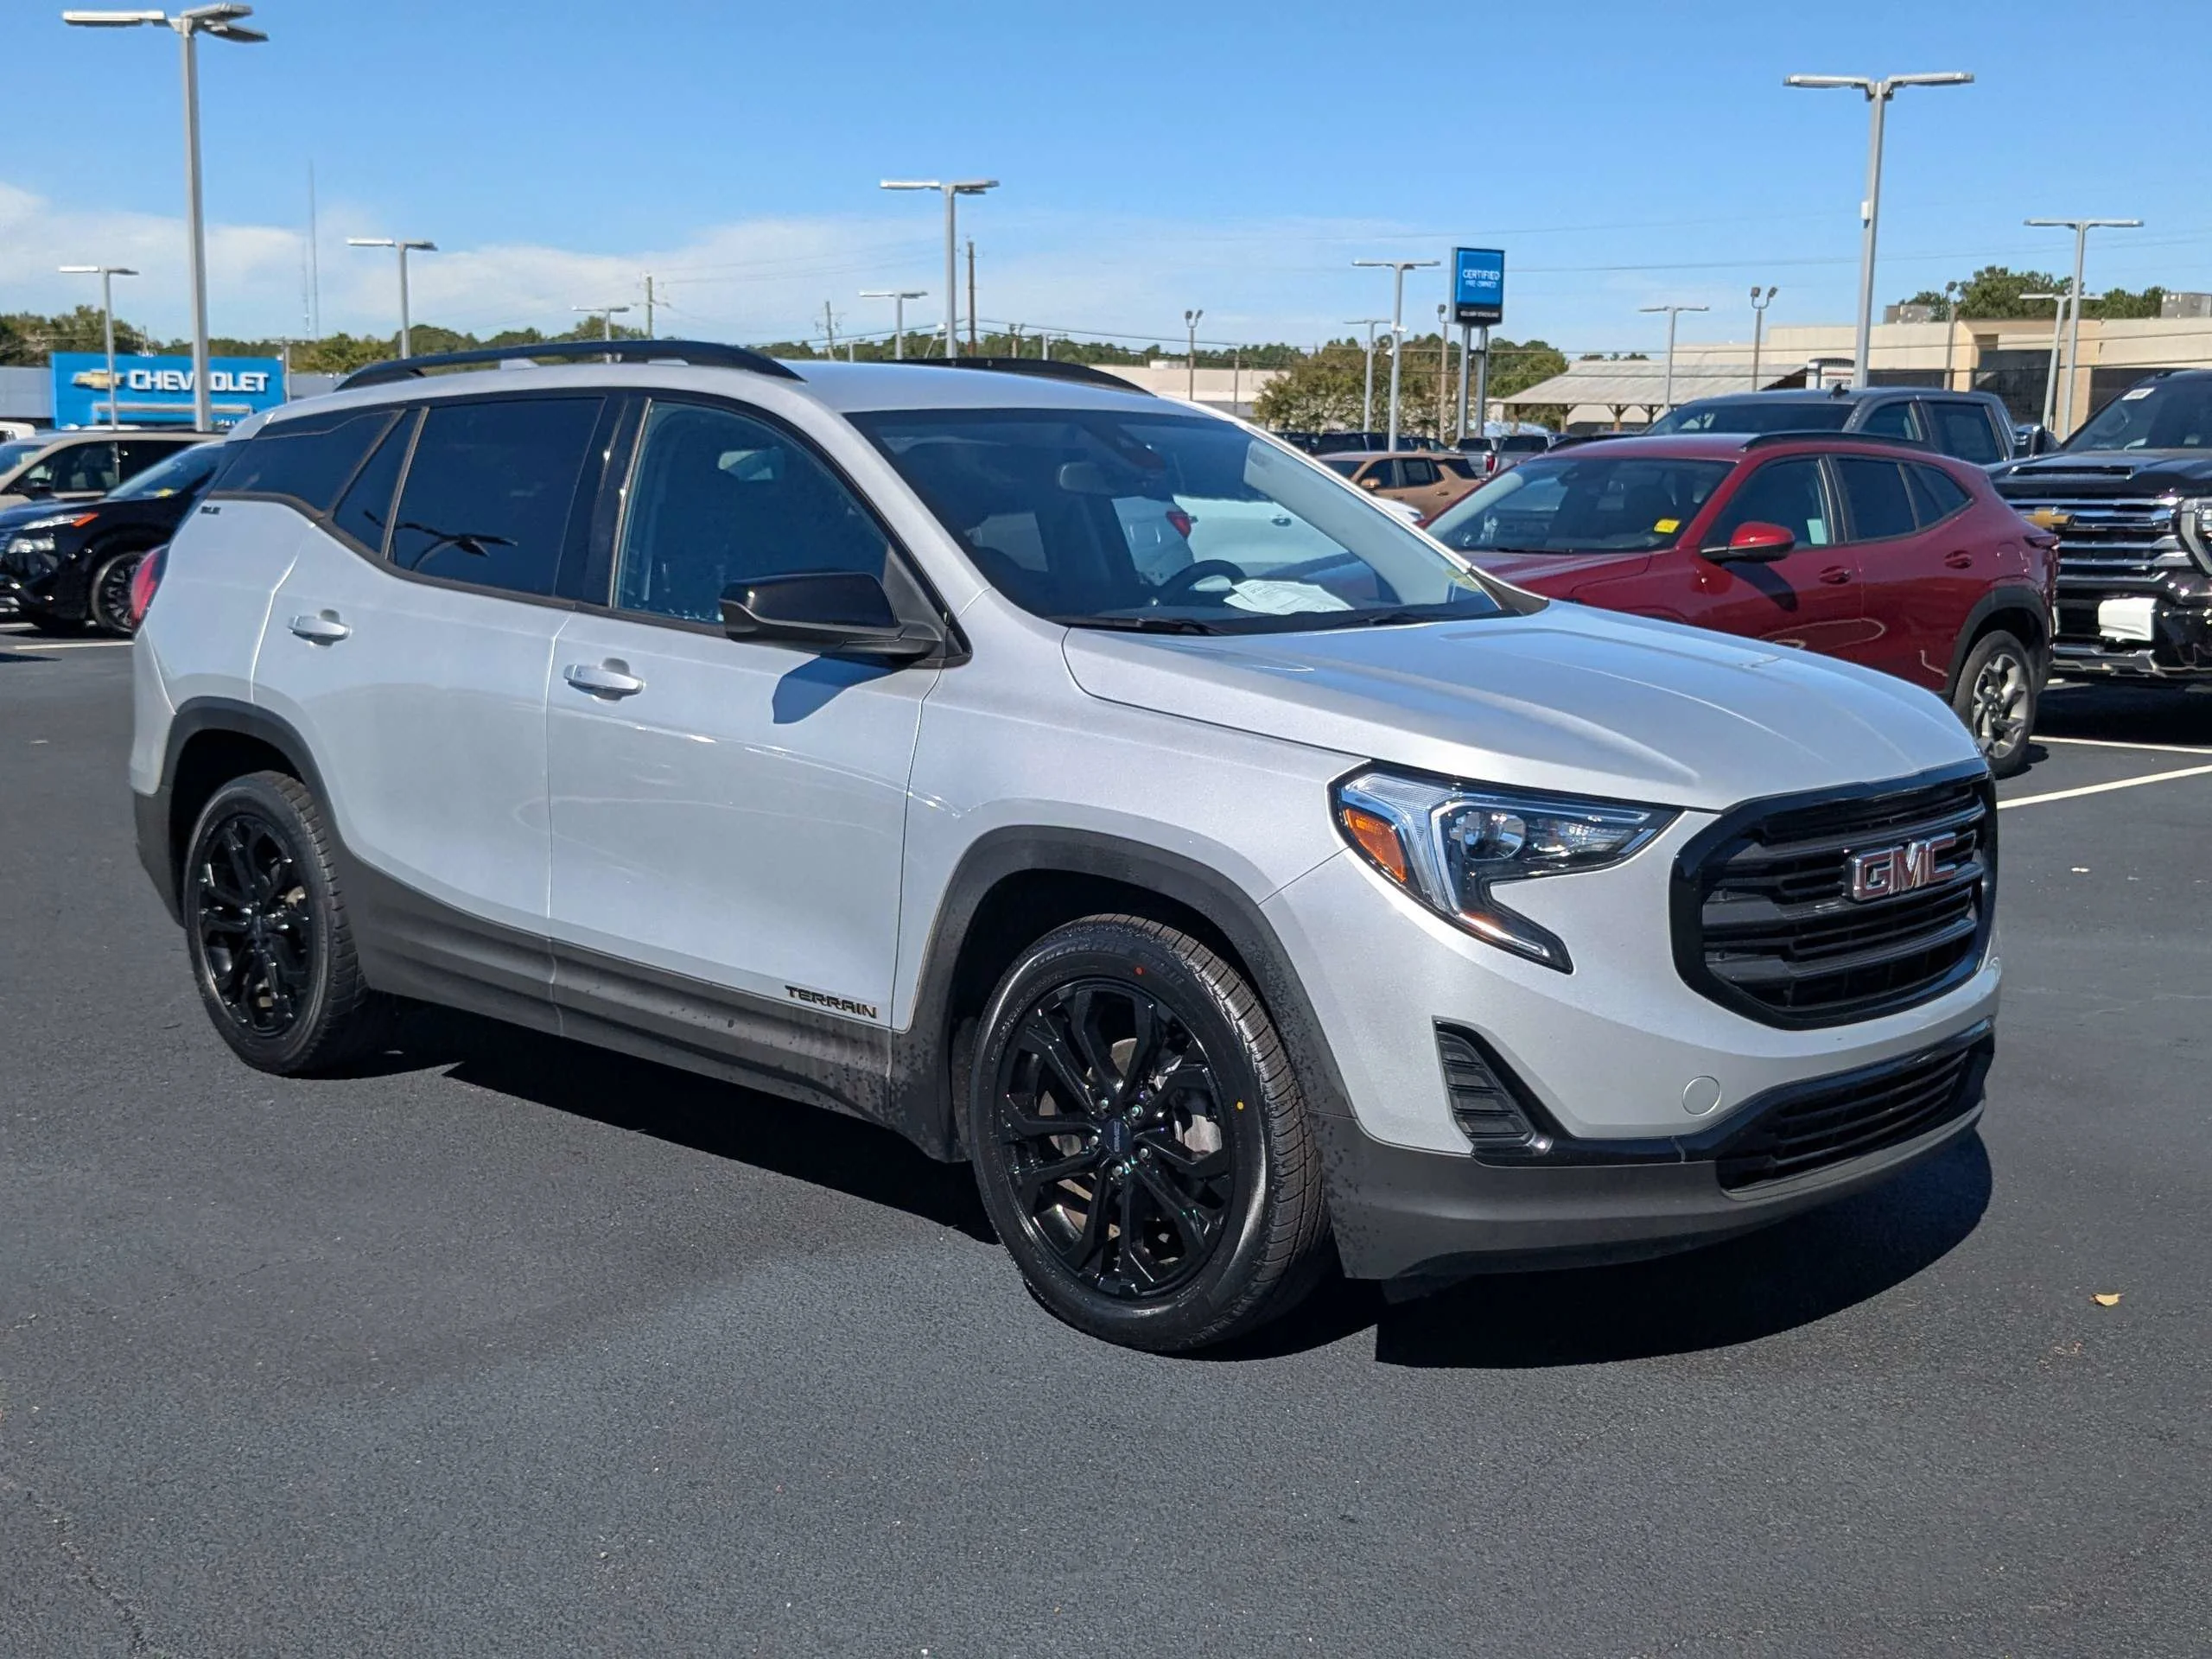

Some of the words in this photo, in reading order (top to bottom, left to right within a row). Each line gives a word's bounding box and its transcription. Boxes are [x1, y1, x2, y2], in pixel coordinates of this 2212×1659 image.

[1462, 269, 1501, 281] CERTIFIED
[130, 369, 270, 391] CHEVOLET
[1853, 832, 1956, 902] GMC
[785, 984, 878, 1019] TERRAIN
